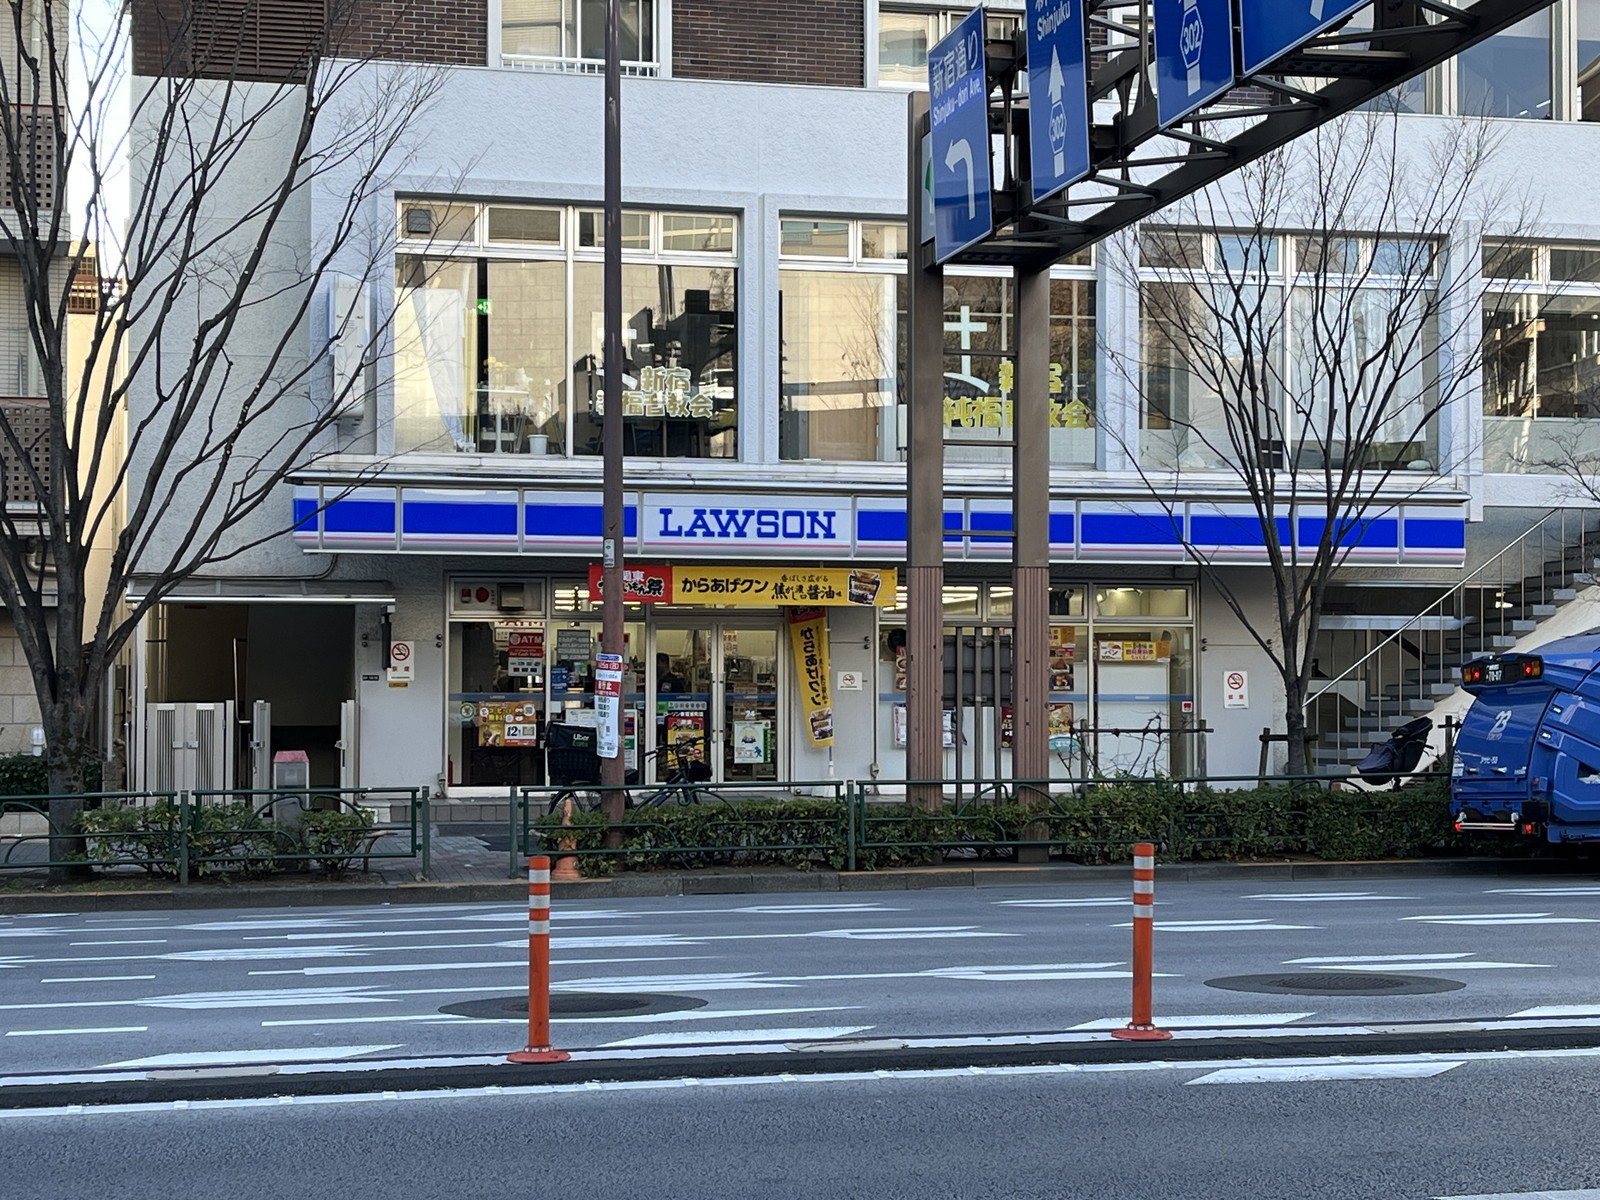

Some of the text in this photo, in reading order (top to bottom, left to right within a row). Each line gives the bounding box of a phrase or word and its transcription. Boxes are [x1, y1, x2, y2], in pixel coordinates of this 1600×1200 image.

[1036, 0, 1071, 41] Shinjuku
[1183, 19, 1201, 55] 302
[932, 30, 978, 98] 新宿通り
[969, 77, 982, 98] Ave.
[1051, 113, 1065, 142] 302
[640, 366, 692, 393] 新宿
[659, 507, 837, 539] LAWSON
[681, 577, 769, 594] からあげクン
[521, 635, 542, 644] ATM
[1489, 710, 1512, 733] 23
[573, 733, 590, 741] Uber
